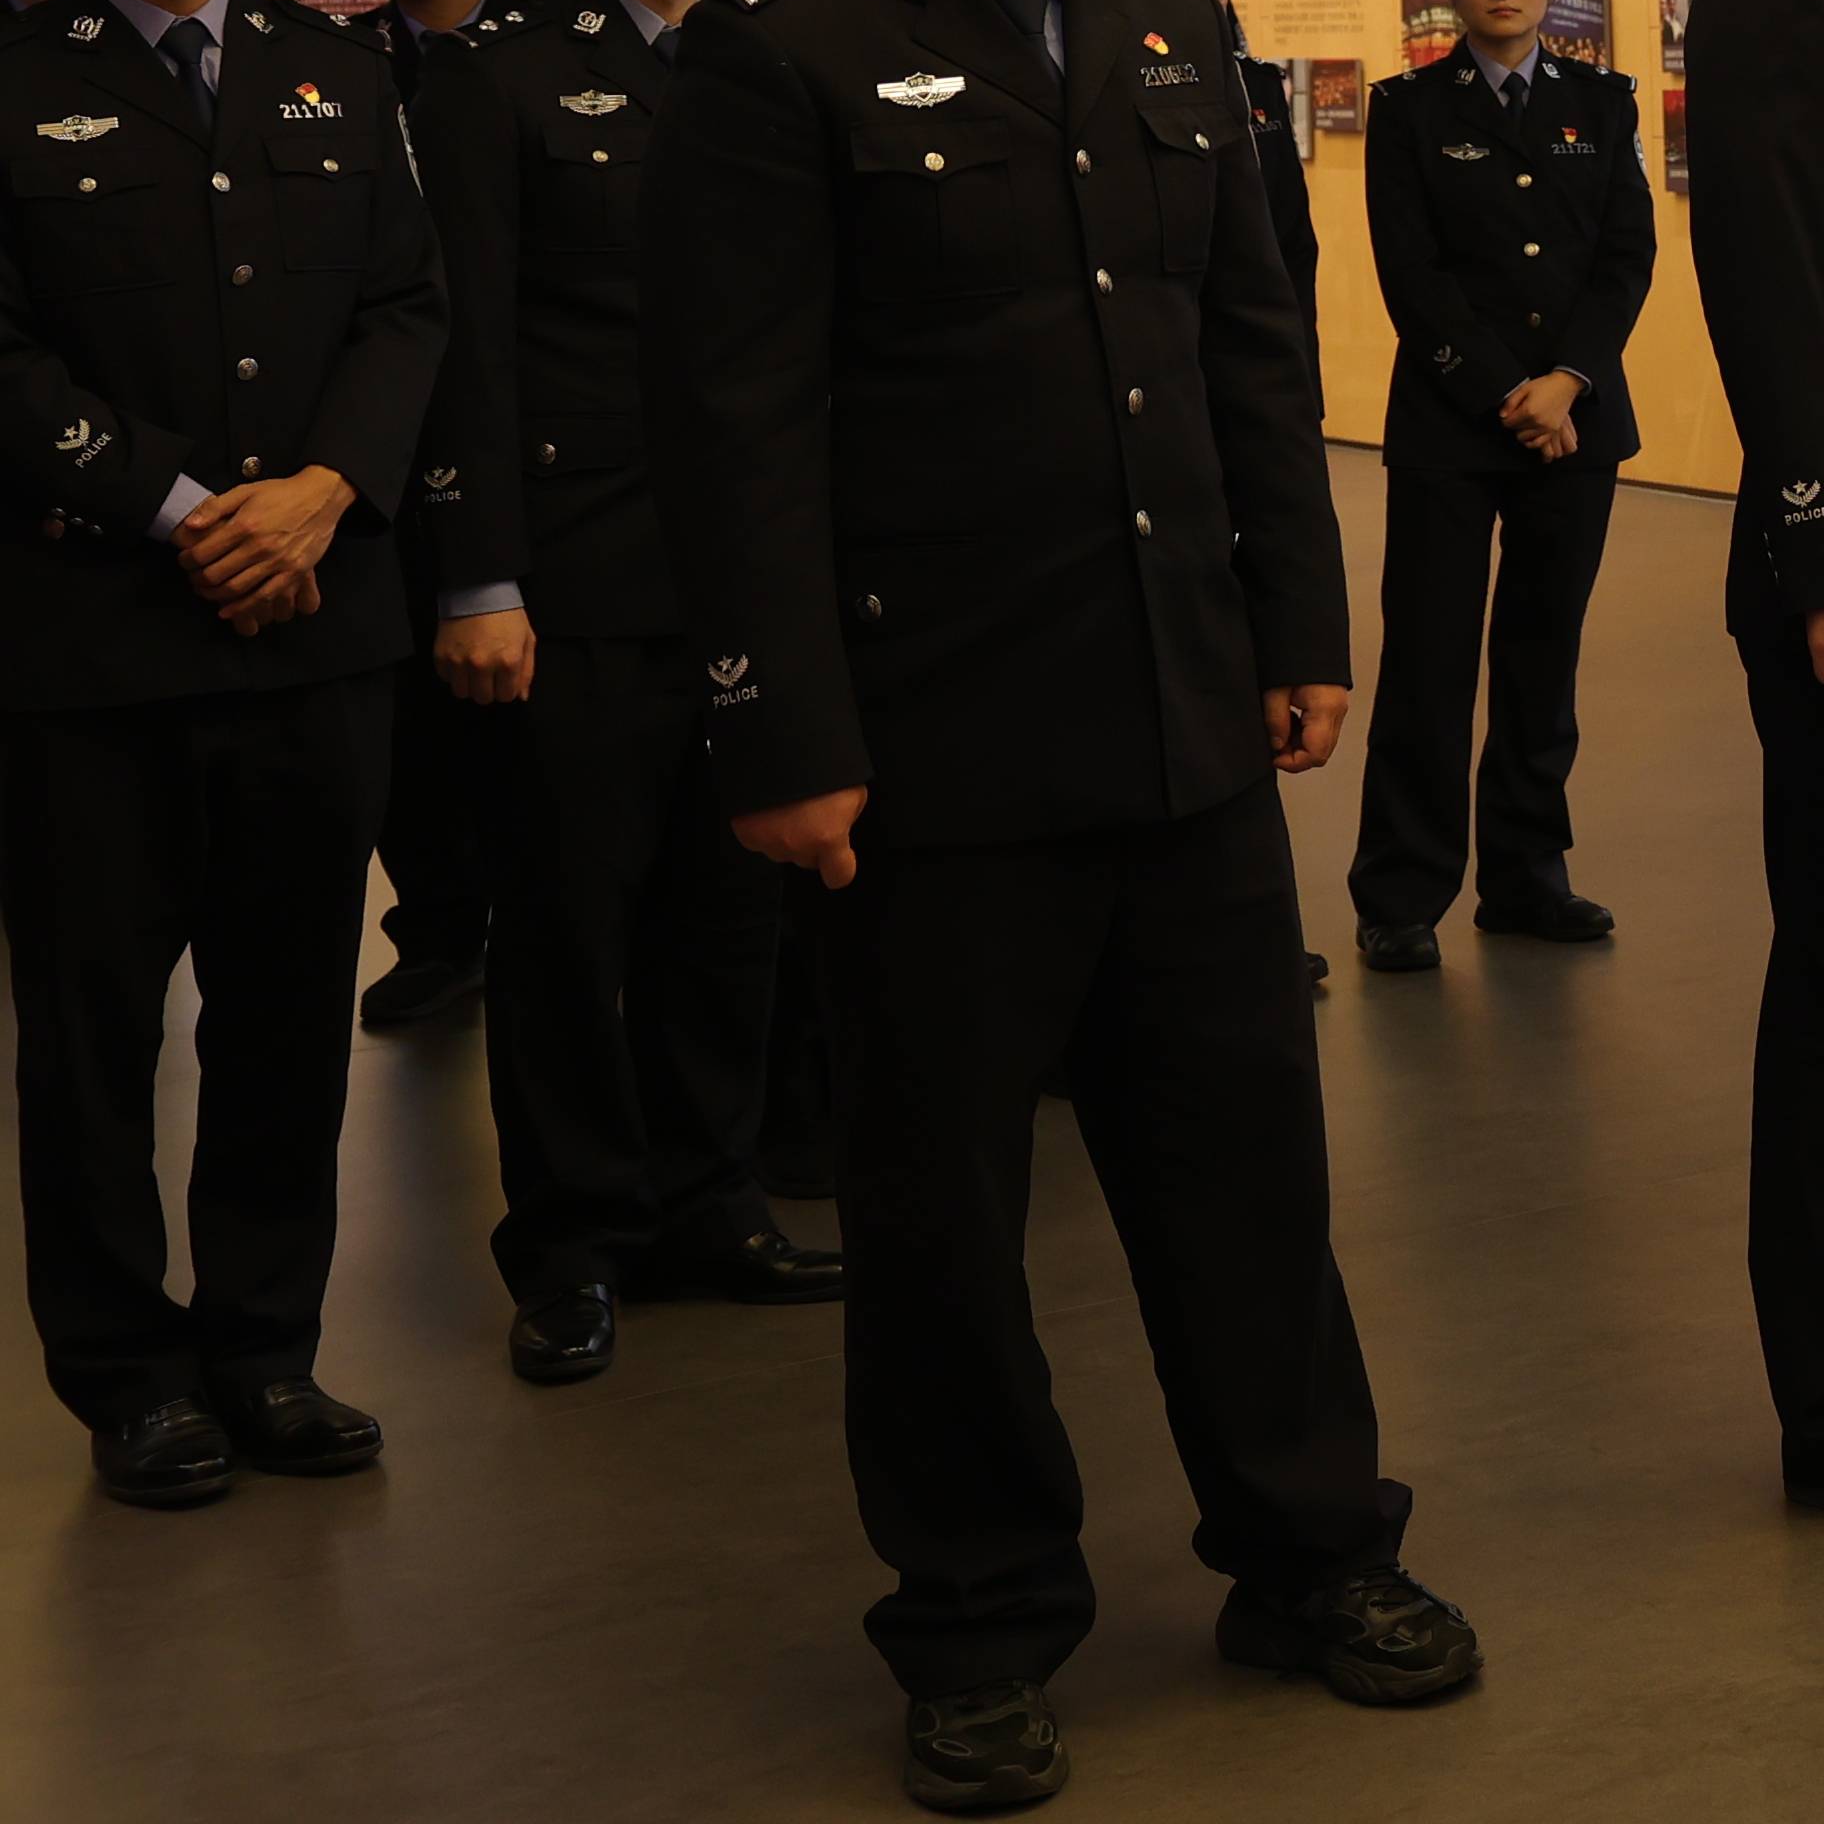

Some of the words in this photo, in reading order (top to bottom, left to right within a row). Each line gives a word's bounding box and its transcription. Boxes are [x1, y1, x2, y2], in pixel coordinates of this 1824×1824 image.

[279, 102, 343, 119] 211707
[75, 432, 112, 468] POLICE
[713, 685, 759, 709] POLICE
